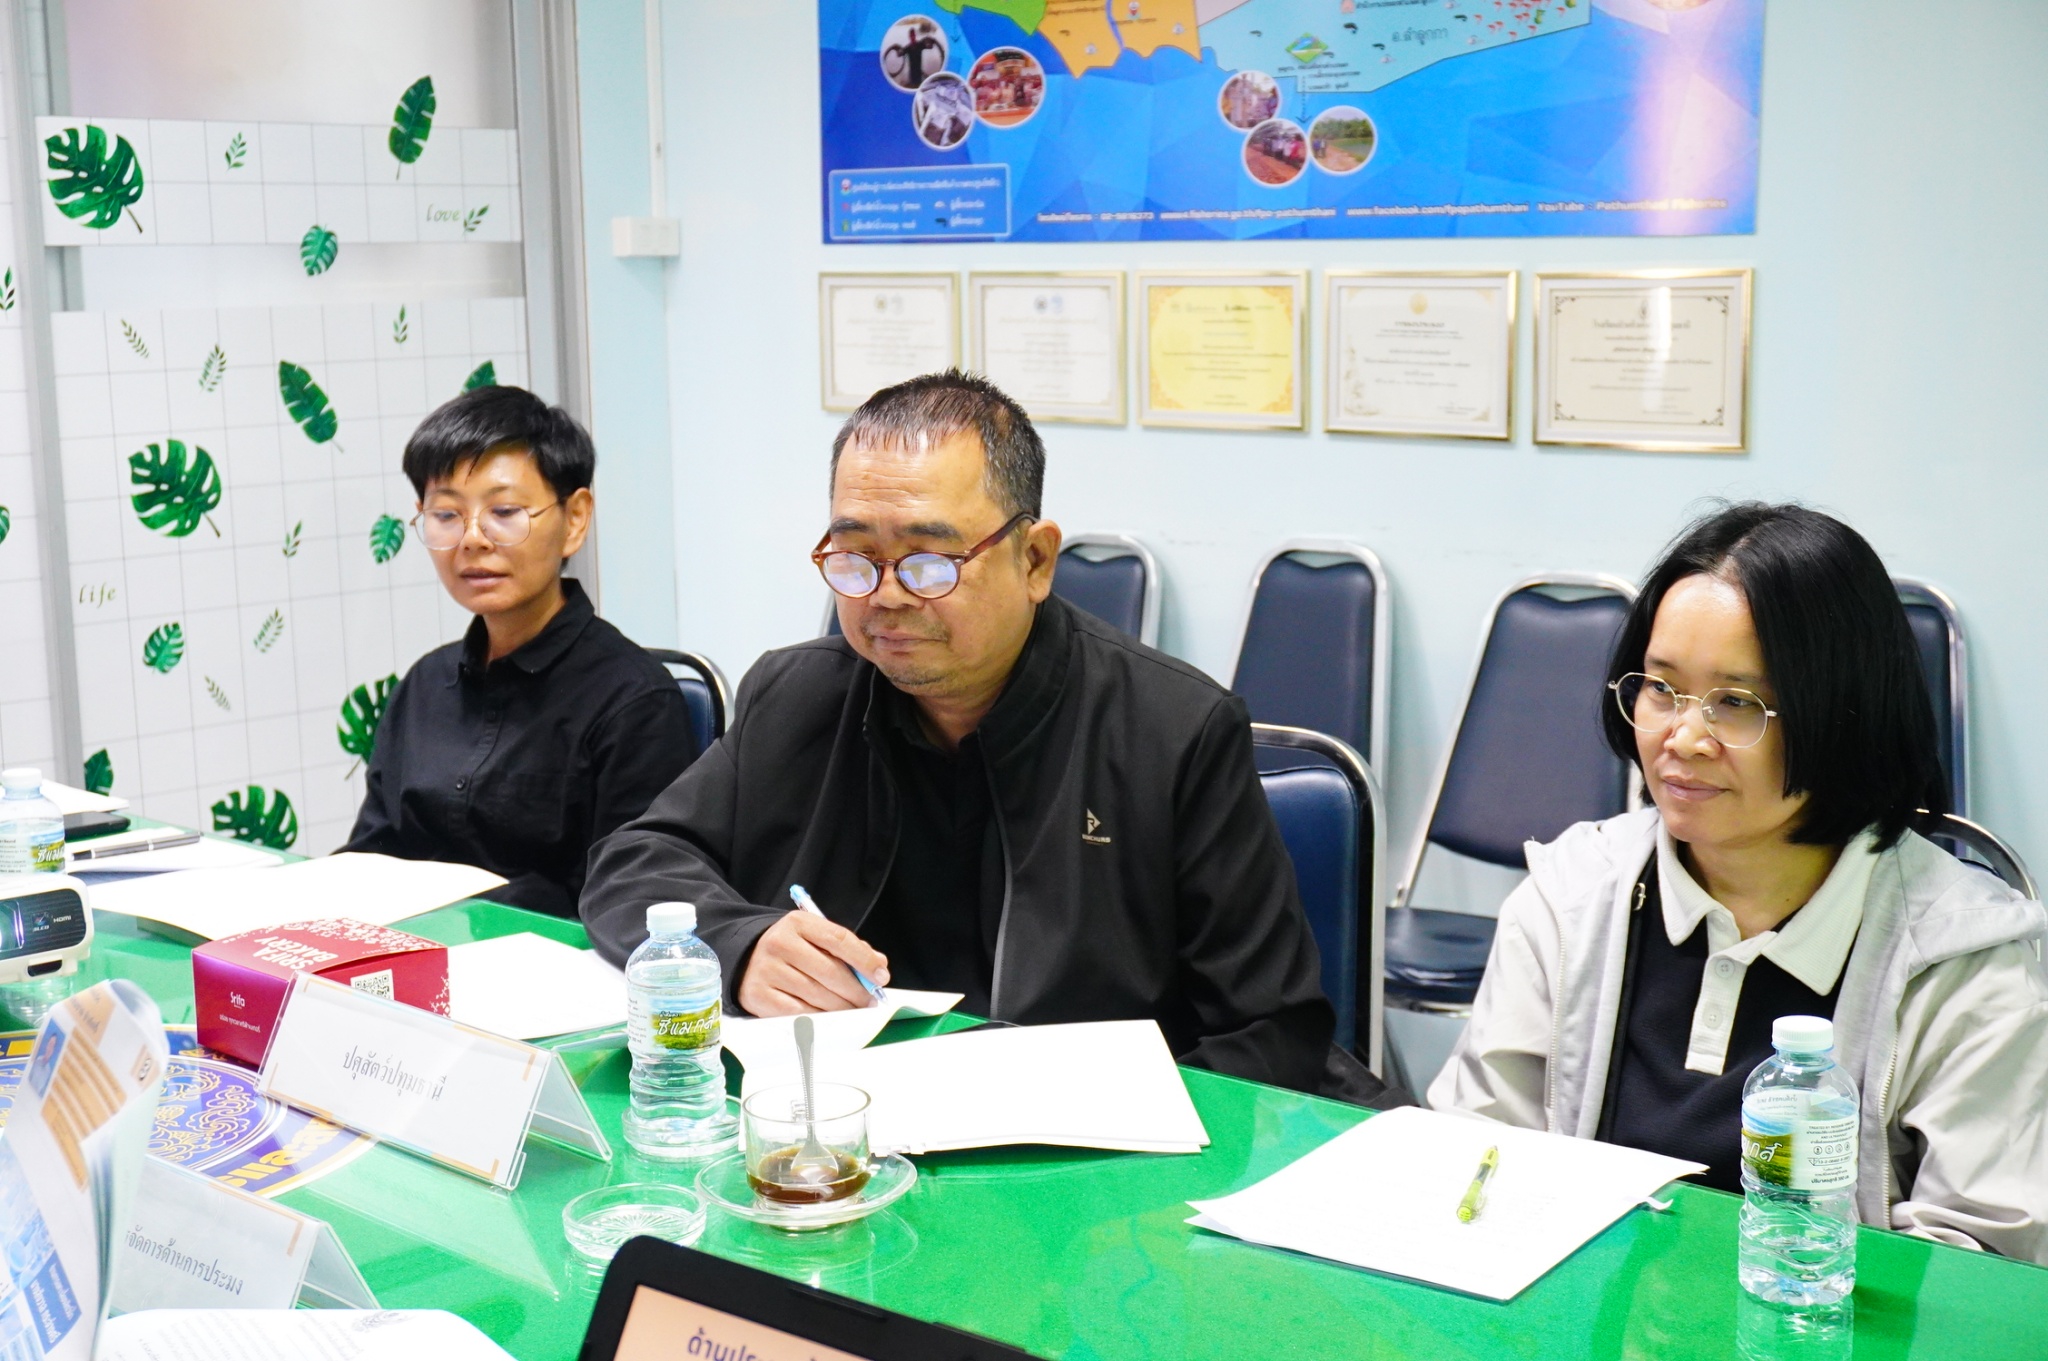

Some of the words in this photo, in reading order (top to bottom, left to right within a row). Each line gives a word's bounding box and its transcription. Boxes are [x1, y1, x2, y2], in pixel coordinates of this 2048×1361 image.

[427, 203, 460, 222] love
[79, 583, 117, 609] life
[53, 915, 72, 923] HDMI
[252, 946, 314, 970] SRIFA
[253, 936, 339, 963] BAKERY
